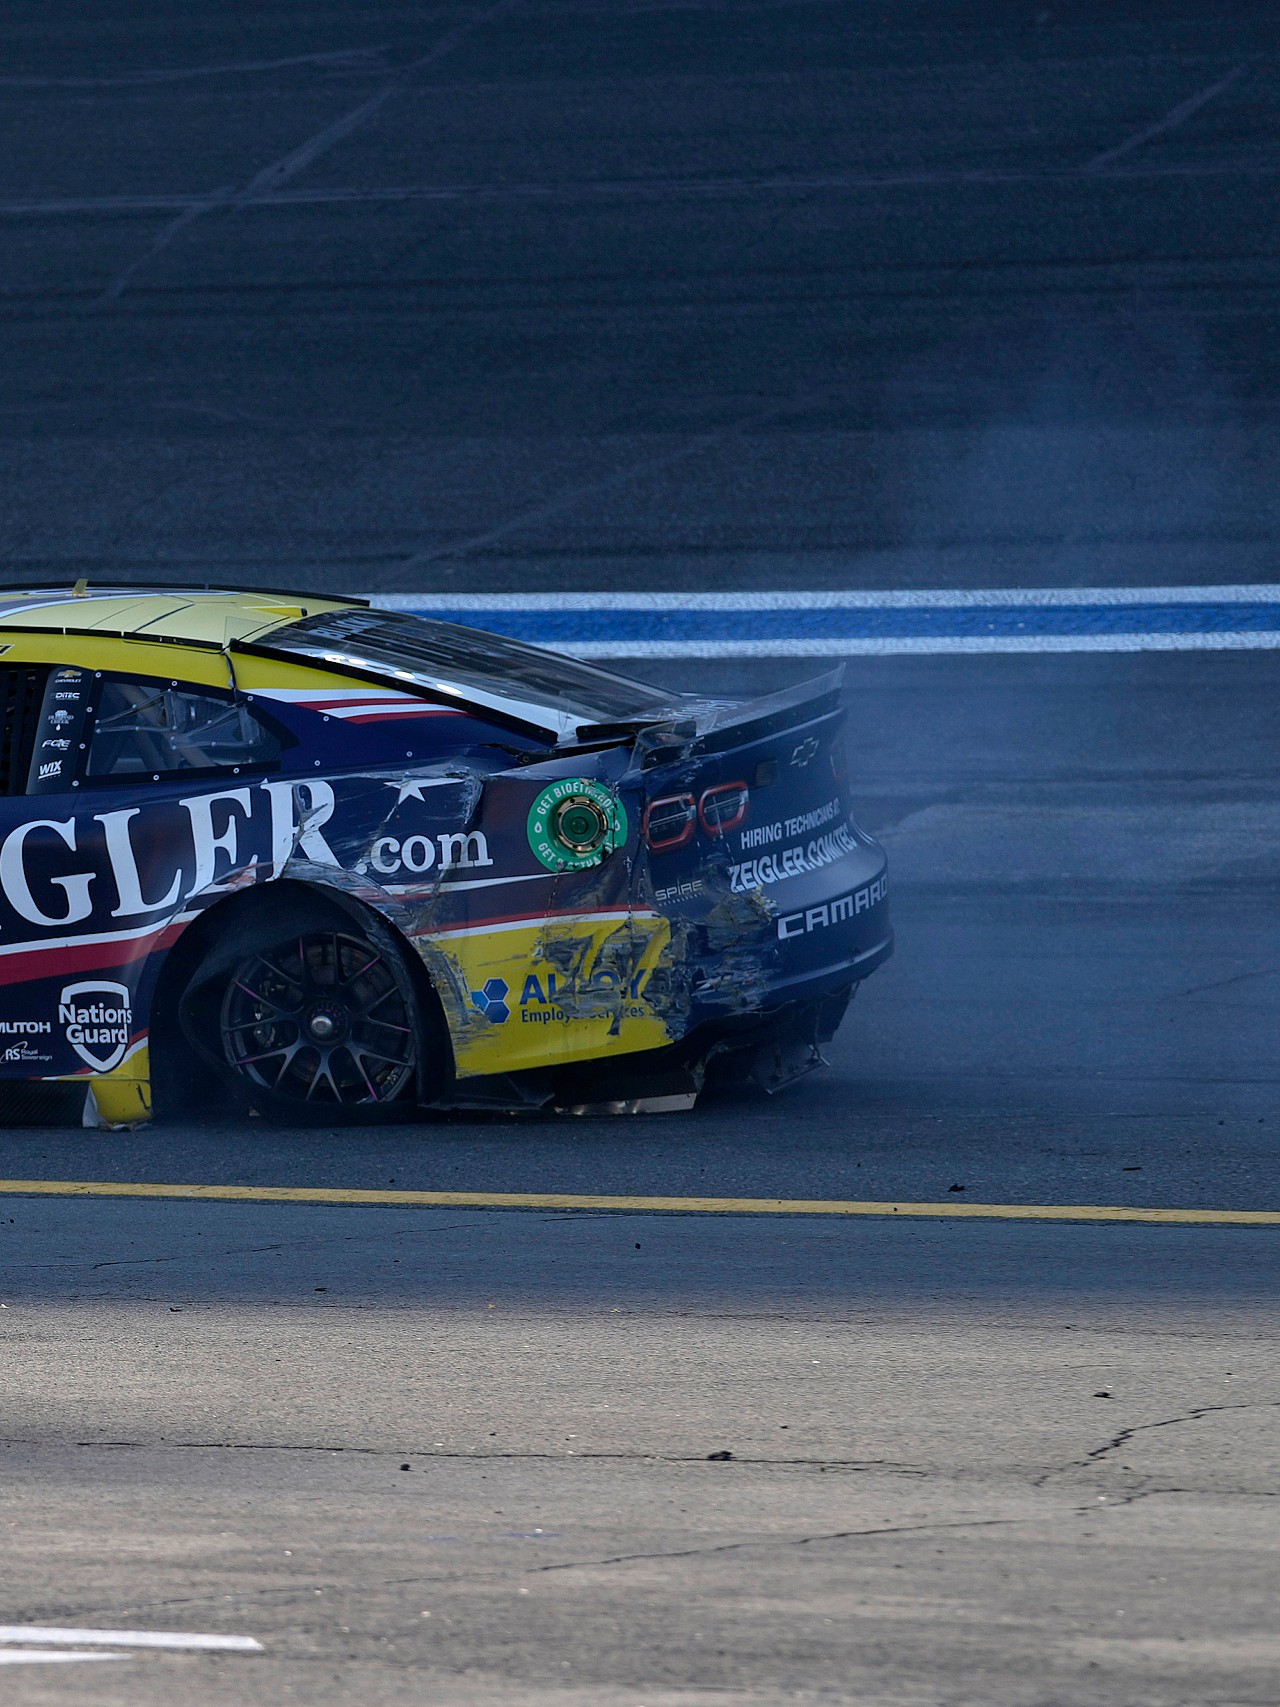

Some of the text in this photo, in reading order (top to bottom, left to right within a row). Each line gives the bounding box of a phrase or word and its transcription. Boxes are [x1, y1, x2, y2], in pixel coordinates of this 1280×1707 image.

[39, 760, 62, 776] WIX
[537, 795, 554, 815] GET
[741, 822, 782, 850] HIRING
[538, 842, 556, 862] GET
[519, 969, 647, 1005] ALOY
[58, 1002, 132, 1024] Nations
[66, 1023, 128, 1044] Guard
